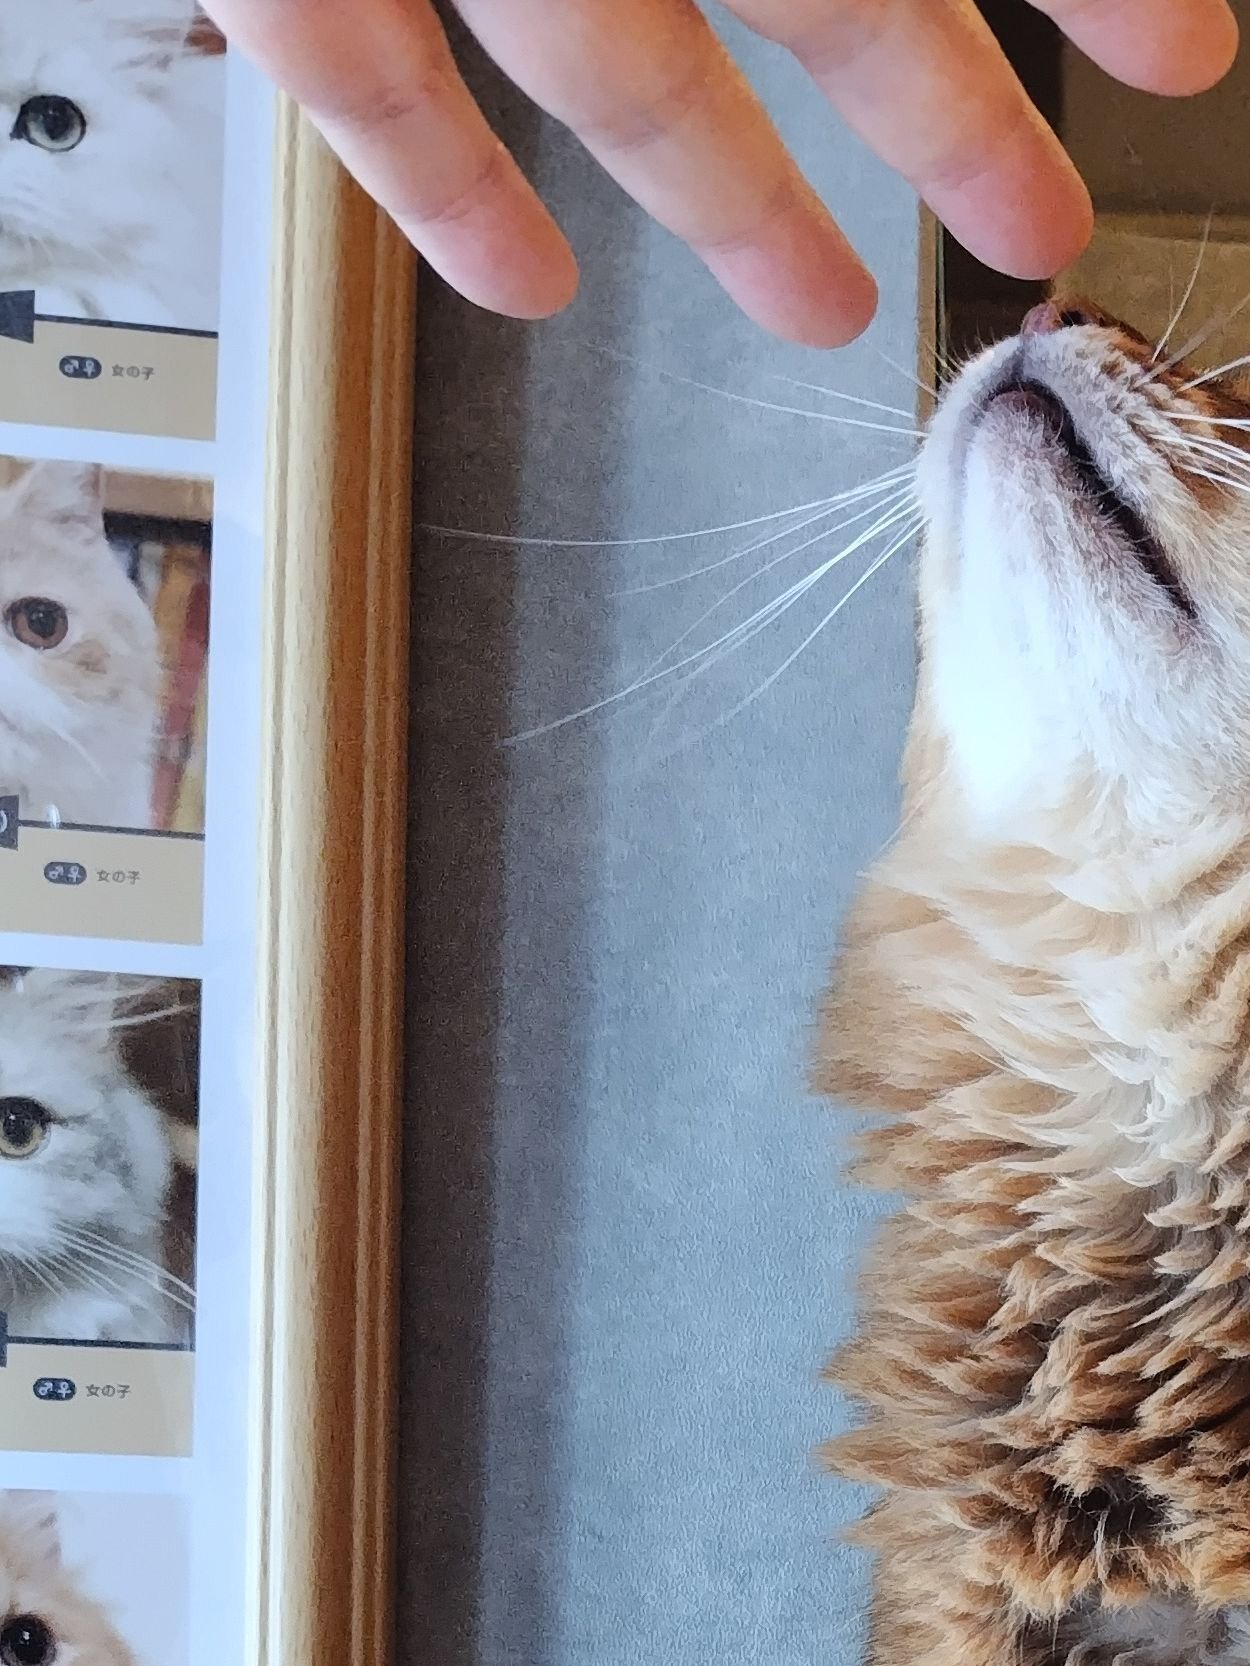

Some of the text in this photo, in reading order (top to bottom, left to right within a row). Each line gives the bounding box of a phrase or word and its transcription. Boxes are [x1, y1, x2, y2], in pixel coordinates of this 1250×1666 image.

[112, 364, 155, 381] 女の子
[97, 870, 141, 885] 女の子
[86, 1384, 131, 1399] 女の子
